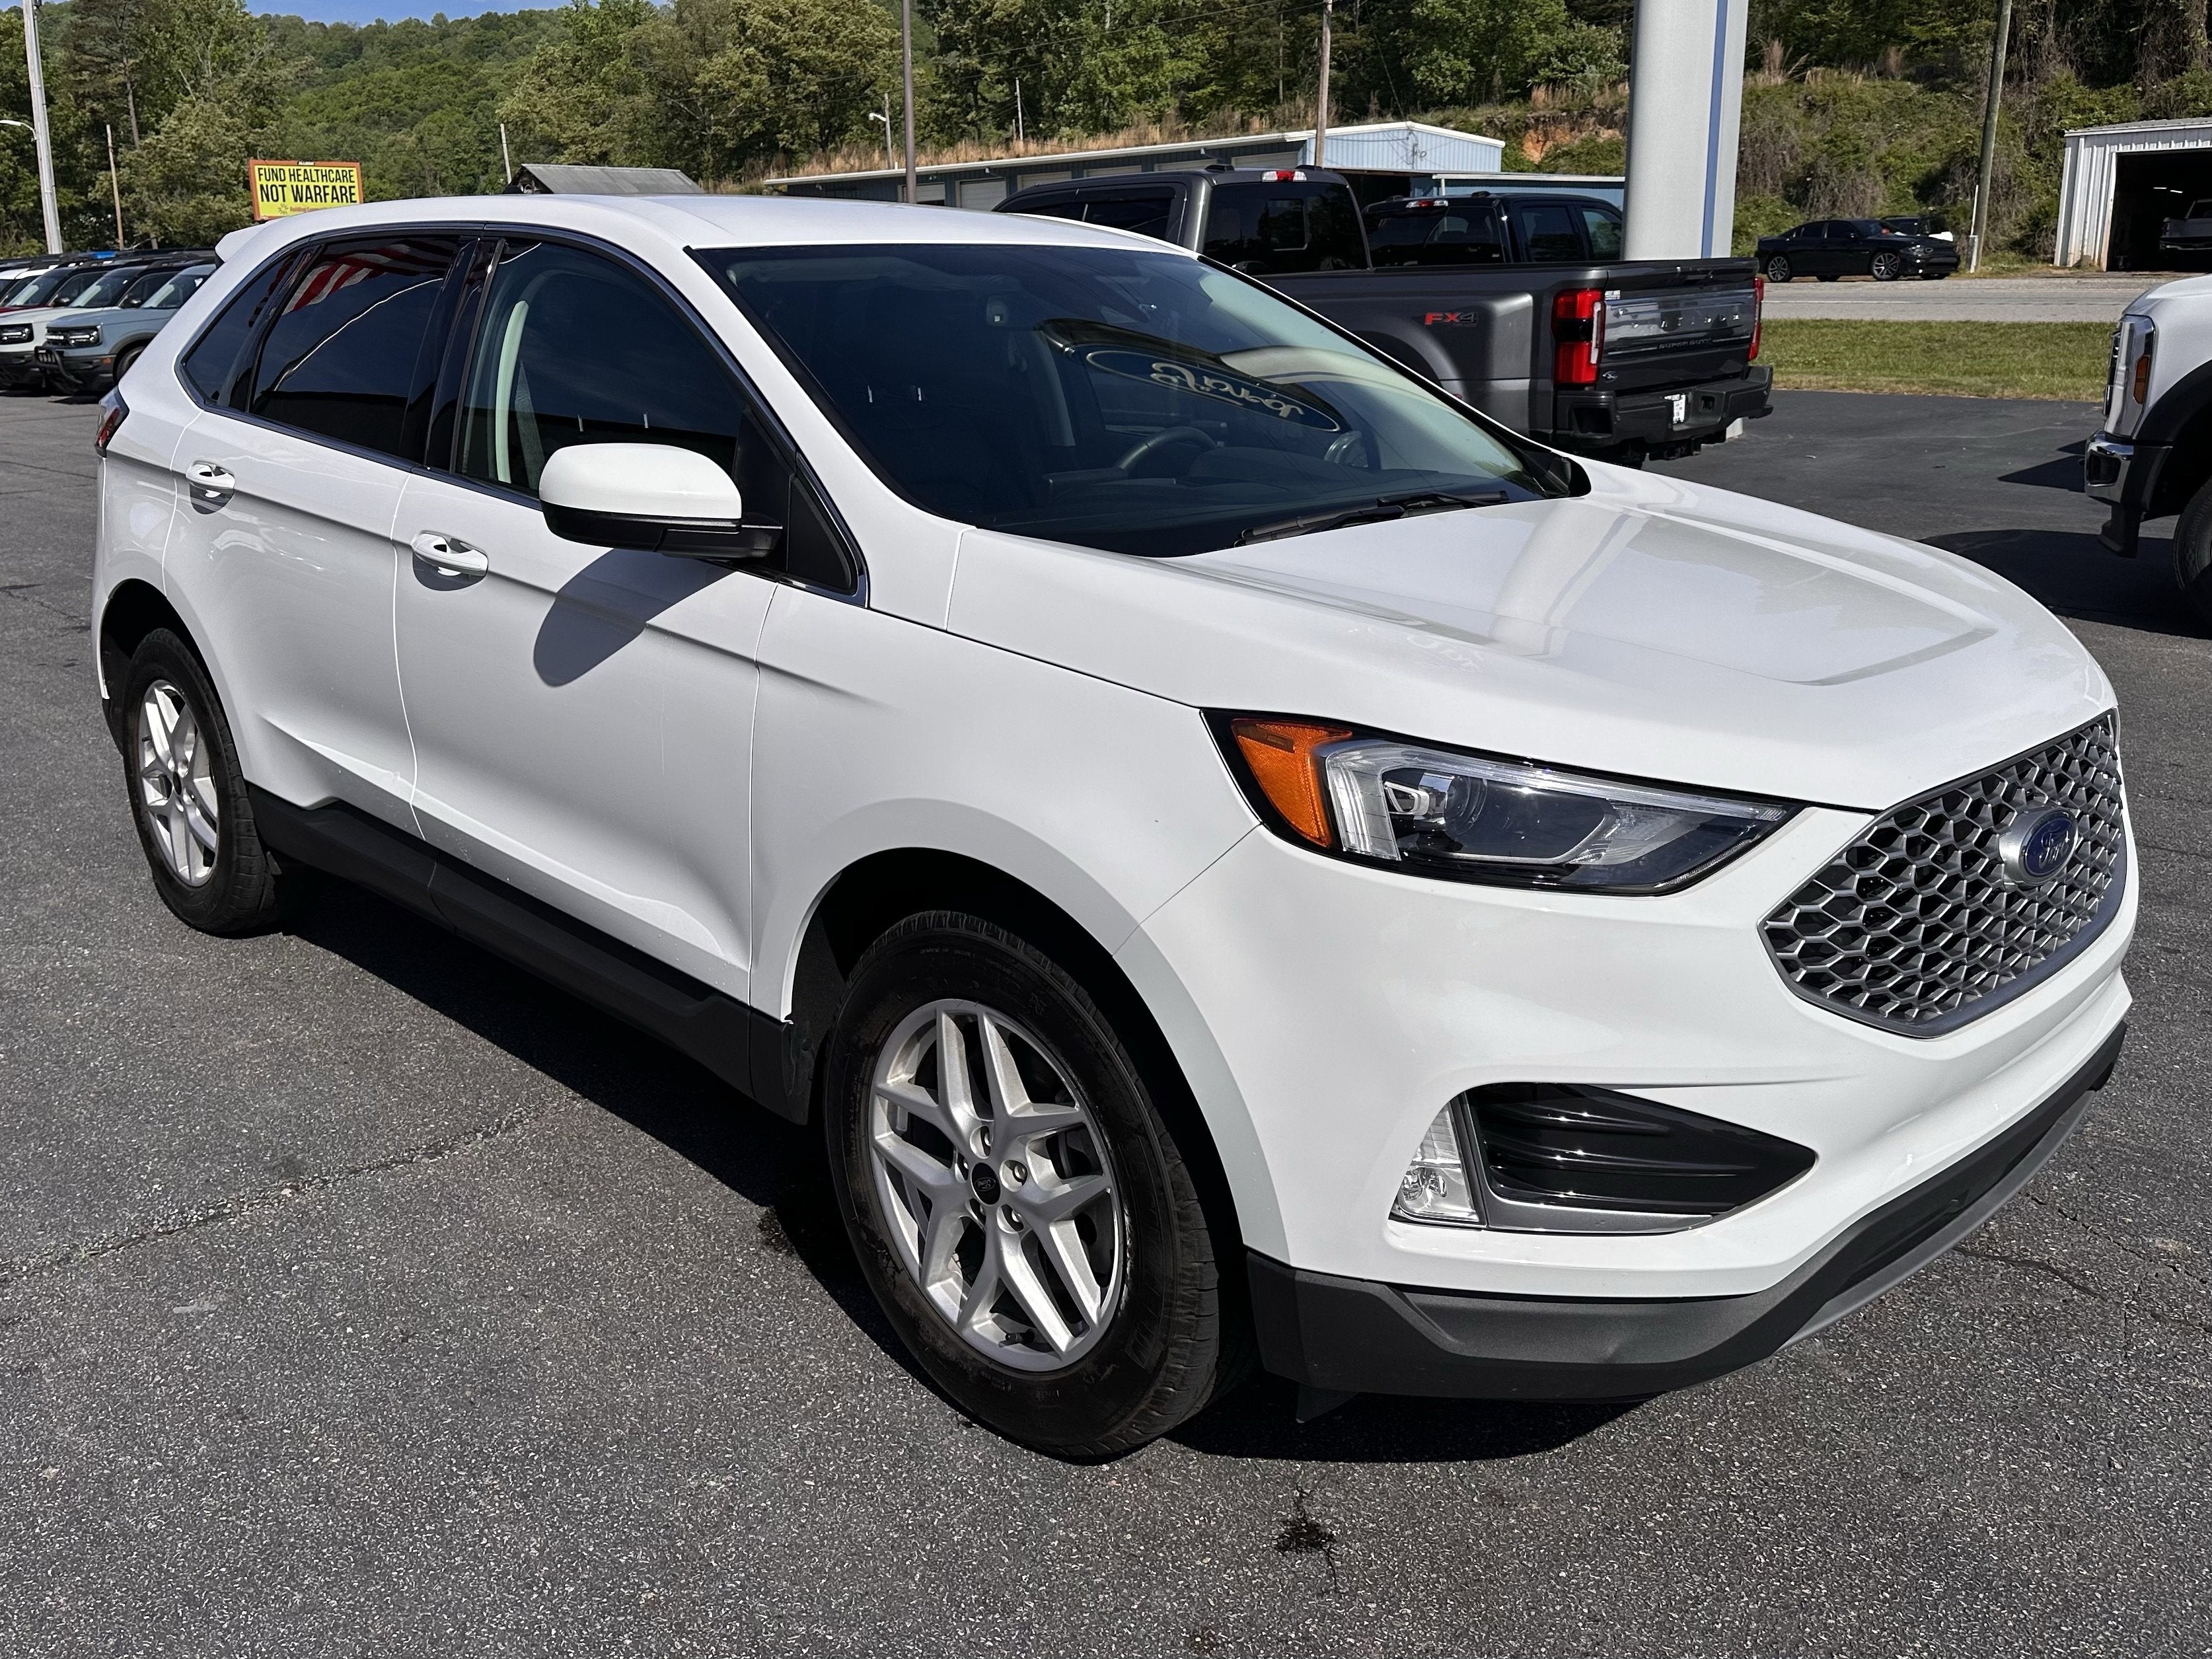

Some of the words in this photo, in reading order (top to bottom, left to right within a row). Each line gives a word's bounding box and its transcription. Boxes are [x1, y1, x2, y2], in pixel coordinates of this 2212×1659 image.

[258, 167, 286, 182] FUND
[289, 168, 355, 184] HEALTHCARE
[260, 184, 287, 203] NOT
[291, 184, 357, 203] WARFARE
[1424, 312, 1479, 326] FX4
[2038, 825, 2070, 869] Ford
[977, 1179, 991, 1189] Ford
